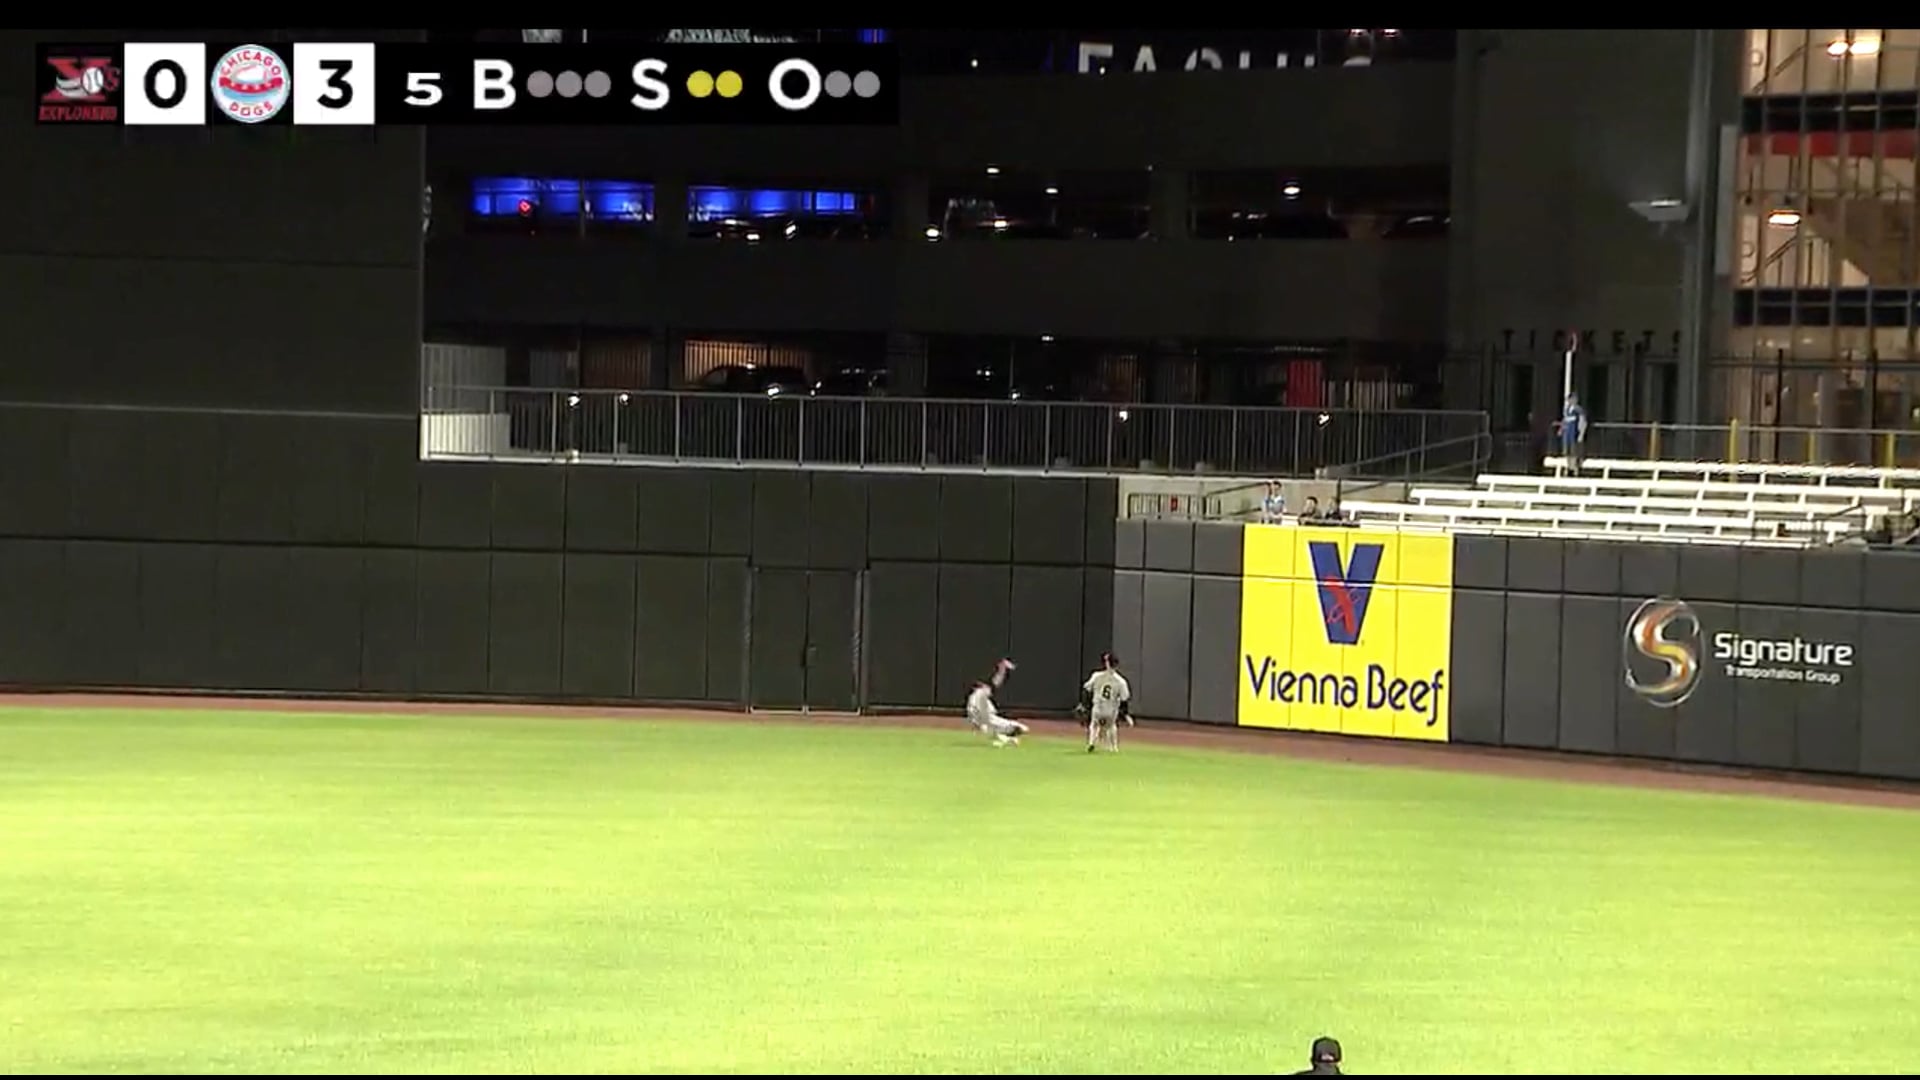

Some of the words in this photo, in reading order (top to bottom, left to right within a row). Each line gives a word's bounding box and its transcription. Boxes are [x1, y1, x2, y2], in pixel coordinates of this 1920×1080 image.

[1715, 633, 1853, 665] Signature
[1725, 664, 1803, 681] Transportation
[1805, 669, 1841, 684] Group
[1102, 684, 1112, 699] 6
[1246, 654, 1358, 708] Vienna
[1367, 664, 1443, 727] Beef
